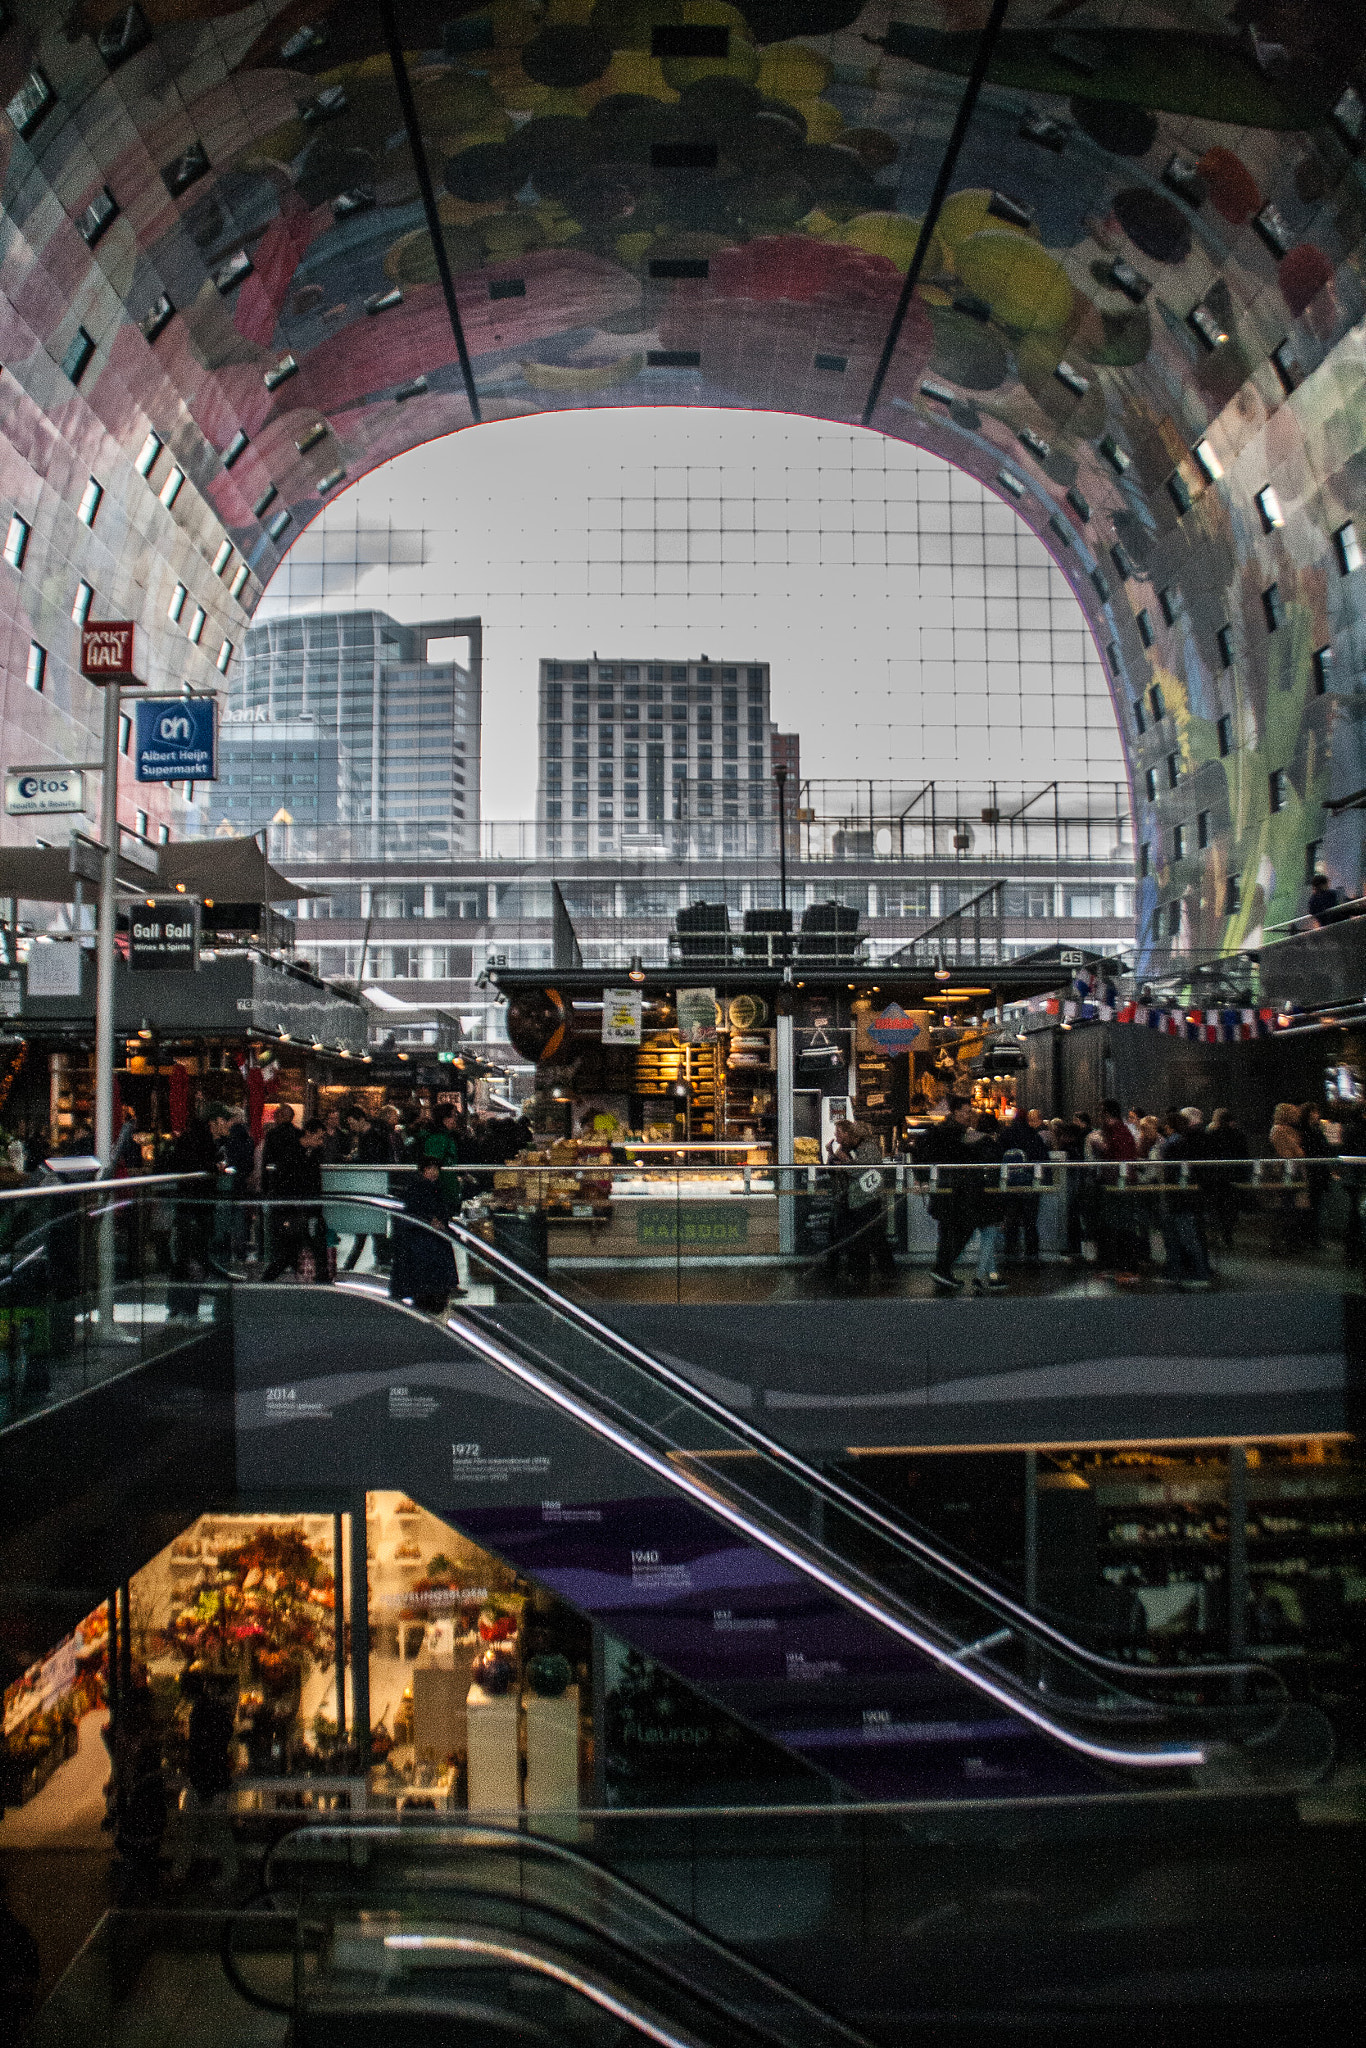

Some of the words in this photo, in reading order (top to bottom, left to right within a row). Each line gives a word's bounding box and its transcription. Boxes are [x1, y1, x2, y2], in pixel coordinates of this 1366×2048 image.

[83, 630, 129, 645] MARKT
[141, 750, 176, 761] Albert
[179, 750, 208, 763] Heijn
[142, 763, 207, 776] Supermarkt
[133, 923, 160, 939] Gall
[165, 923, 192, 939] Gall
[487, 955, 507, 966] 48
[266, 1388, 296, 1400] 2014
[451, 1443, 480, 1456] 1972
[631, 1550, 659, 1563] 1940
